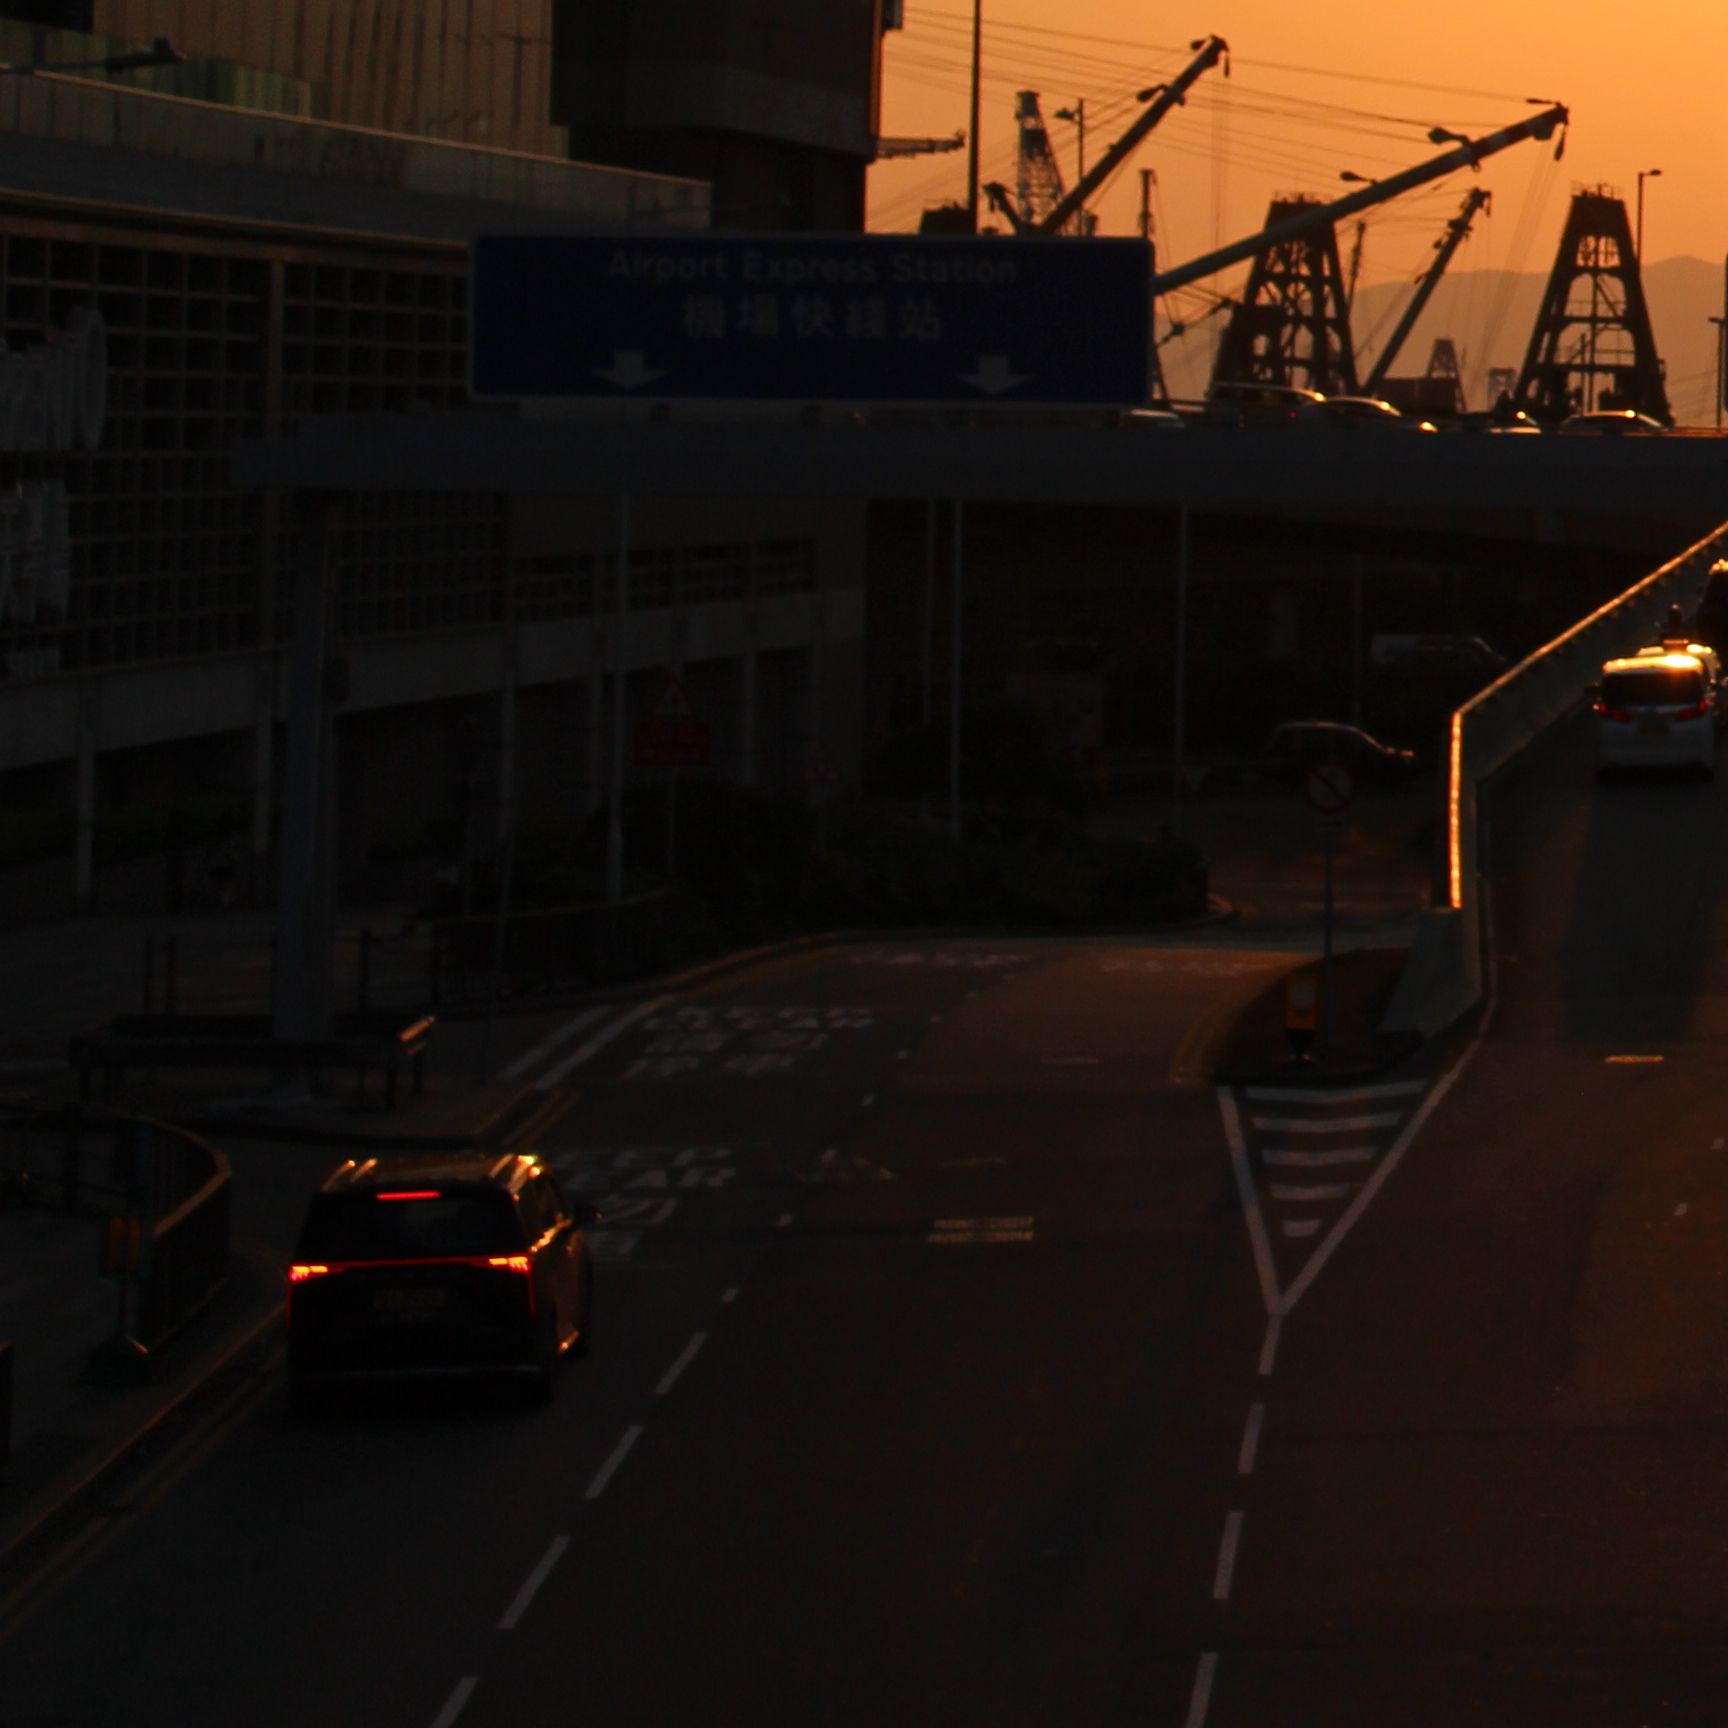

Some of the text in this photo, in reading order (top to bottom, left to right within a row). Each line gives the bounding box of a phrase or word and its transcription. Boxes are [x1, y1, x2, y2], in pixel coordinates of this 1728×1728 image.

[607, 249, 1018, 286] Airport Express Station
